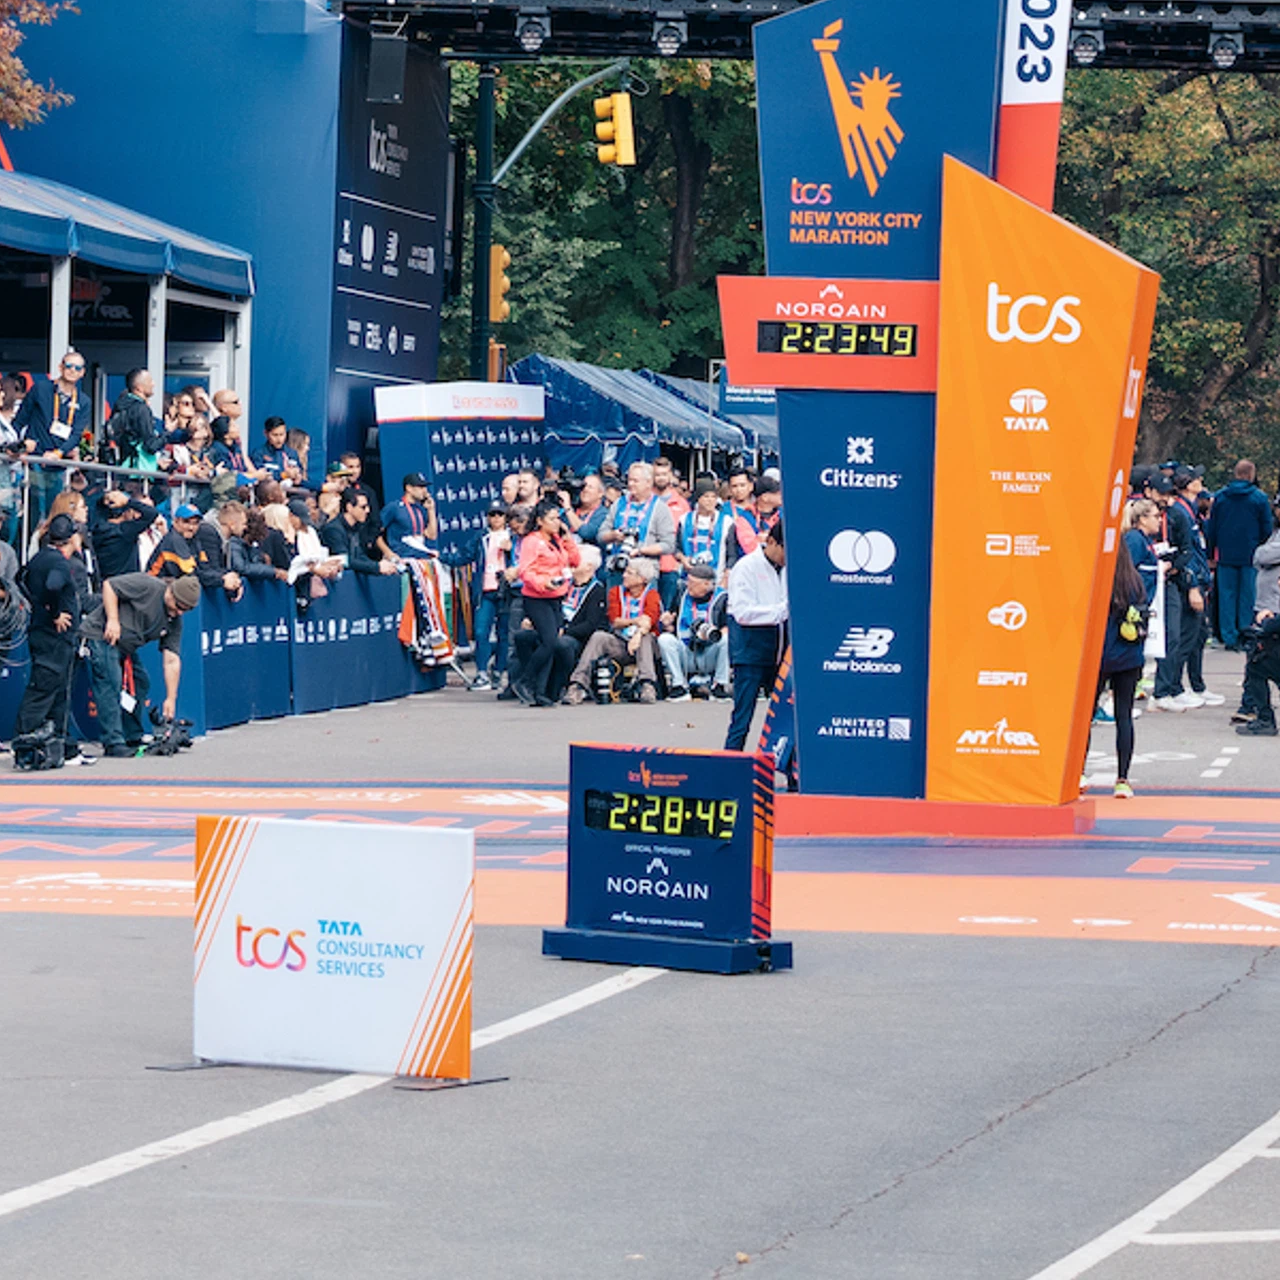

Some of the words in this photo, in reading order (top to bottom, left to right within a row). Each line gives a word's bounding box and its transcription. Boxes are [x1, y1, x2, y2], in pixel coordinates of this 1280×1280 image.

[791, 177, 832, 204] tcs
[791, 211, 831, 227] NEW
[835, 212, 882, 228] YORK
[884, 213, 921, 228] CITY
[790, 228, 889, 245] MARATHON
[776, 302, 886, 318] NORQAIN
[987, 282, 1081, 342] tcs
[1003, 417, 1049, 431] TATA
[821, 468, 898, 488] Citizens
[990, 471, 1012, 481] THE
[1016, 472, 1051, 482] RUDIN
[1002, 483, 1041, 493] FAMILY
[830, 574, 893, 584] mastercard
[823, 661, 849, 671] new
[851, 660, 902, 673] balance
[977, 671, 1027, 686] ESPN
[832, 718, 886, 727] UNITED
[817, 726, 885, 737] AIRLINES
[607, 877, 708, 900] NORQAIN
[317, 919, 362, 937] TATA
[235, 914, 307, 972] tcs
[317, 939, 425, 960] CONSULTANCY
[317, 959, 385, 978] SERVICES
